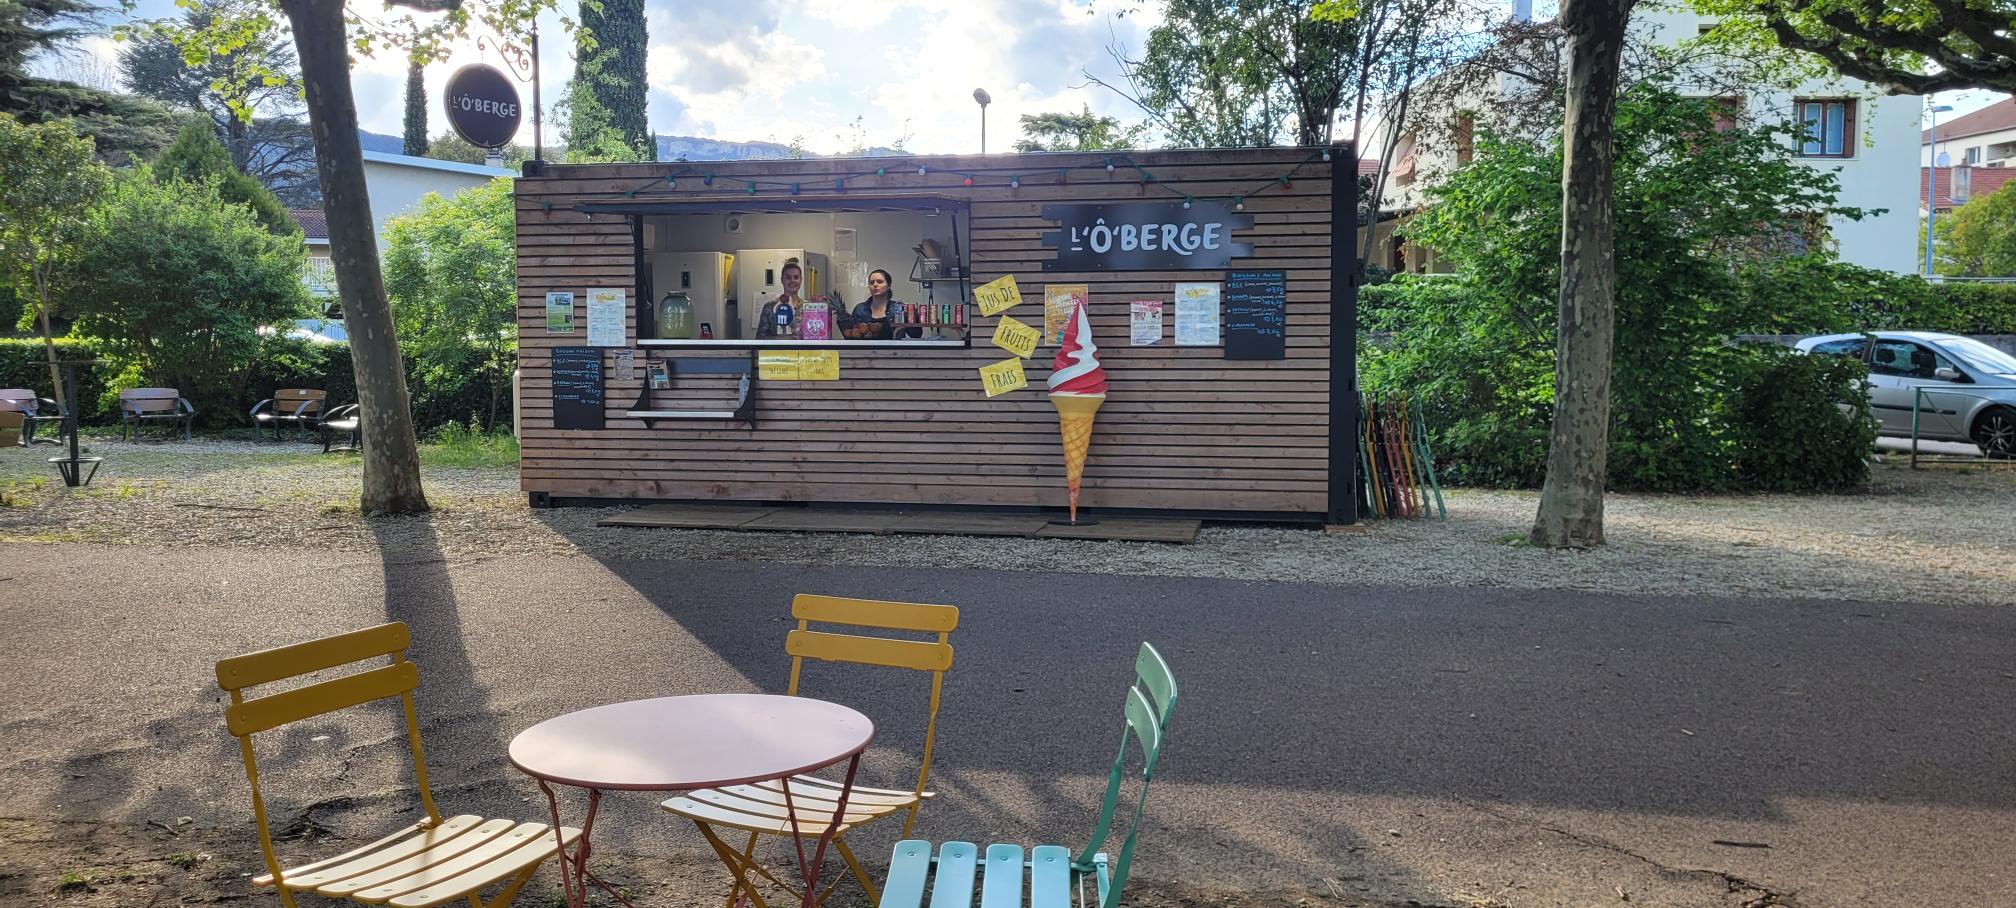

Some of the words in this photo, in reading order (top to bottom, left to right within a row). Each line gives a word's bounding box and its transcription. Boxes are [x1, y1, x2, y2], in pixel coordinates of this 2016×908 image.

[1071, 218, 1222, 255] L'Ô'BERGE
[981, 293, 1001, 311] JUS
[777, 315, 788, 325] m
[1000, 326, 1031, 351] FRUITS
[990, 369, 1017, 389] FRAIS
